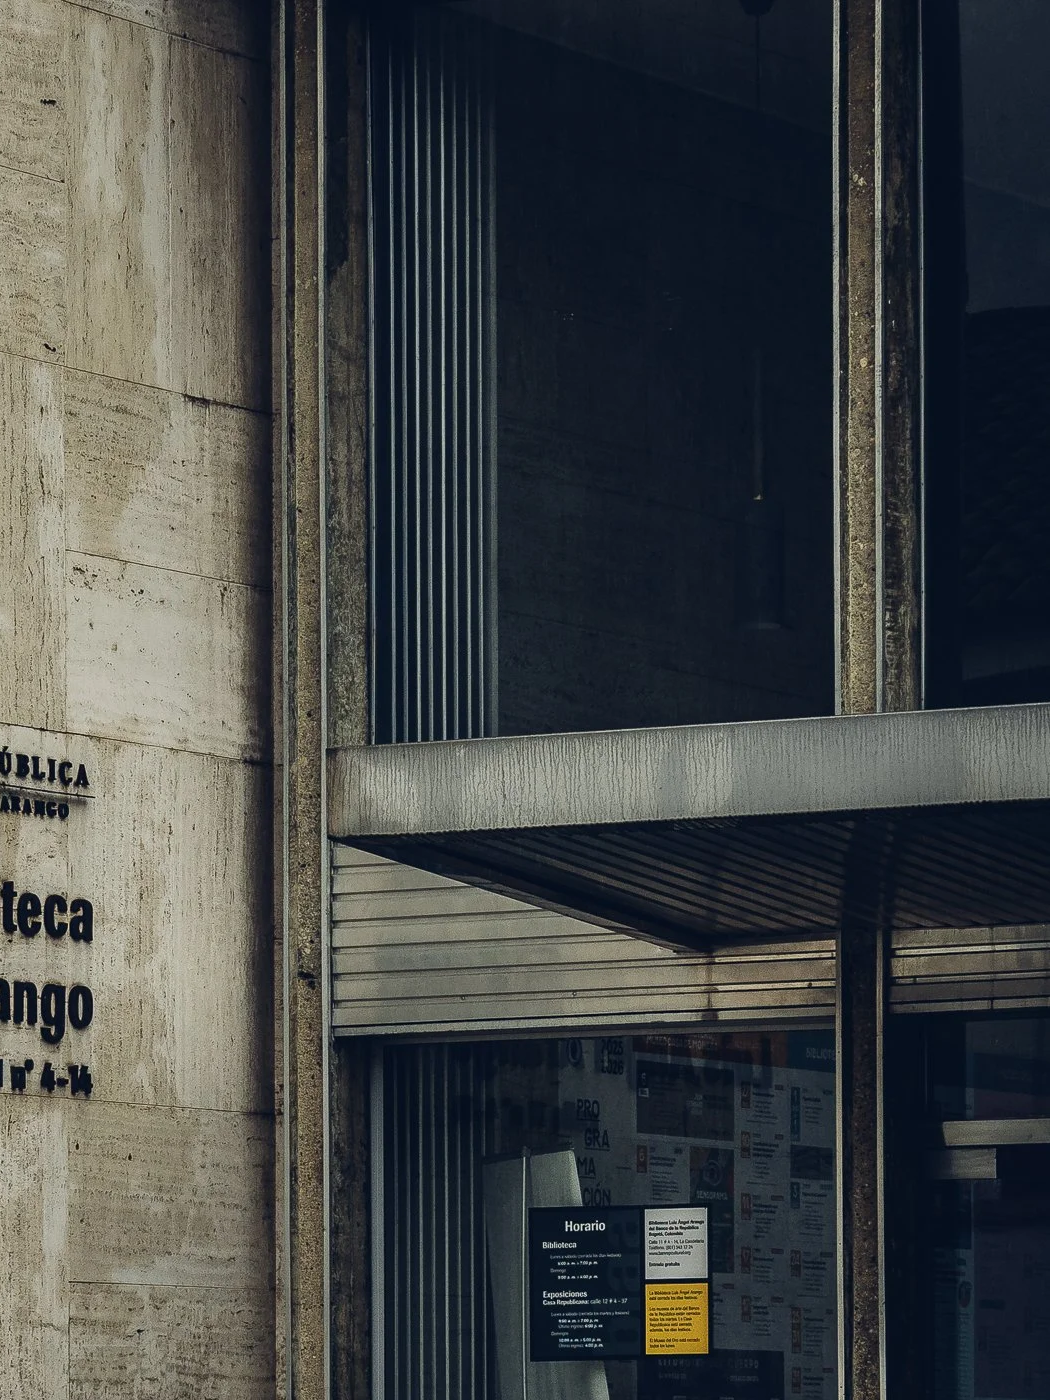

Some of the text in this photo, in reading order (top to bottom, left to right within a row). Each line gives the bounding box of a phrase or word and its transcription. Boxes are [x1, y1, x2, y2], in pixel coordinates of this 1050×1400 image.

[0, 795, 70, 819] ARANGO
[577, 1099, 600, 1119] PRO
[584, 1128, 610, 1148] GRA
[577, 1157, 596, 1176] MA
[565, 1220, 606, 1232] Horario
[542, 1241, 577, 1249] Biblioteca
[542, 1290, 588, 1300] Exposiciones
